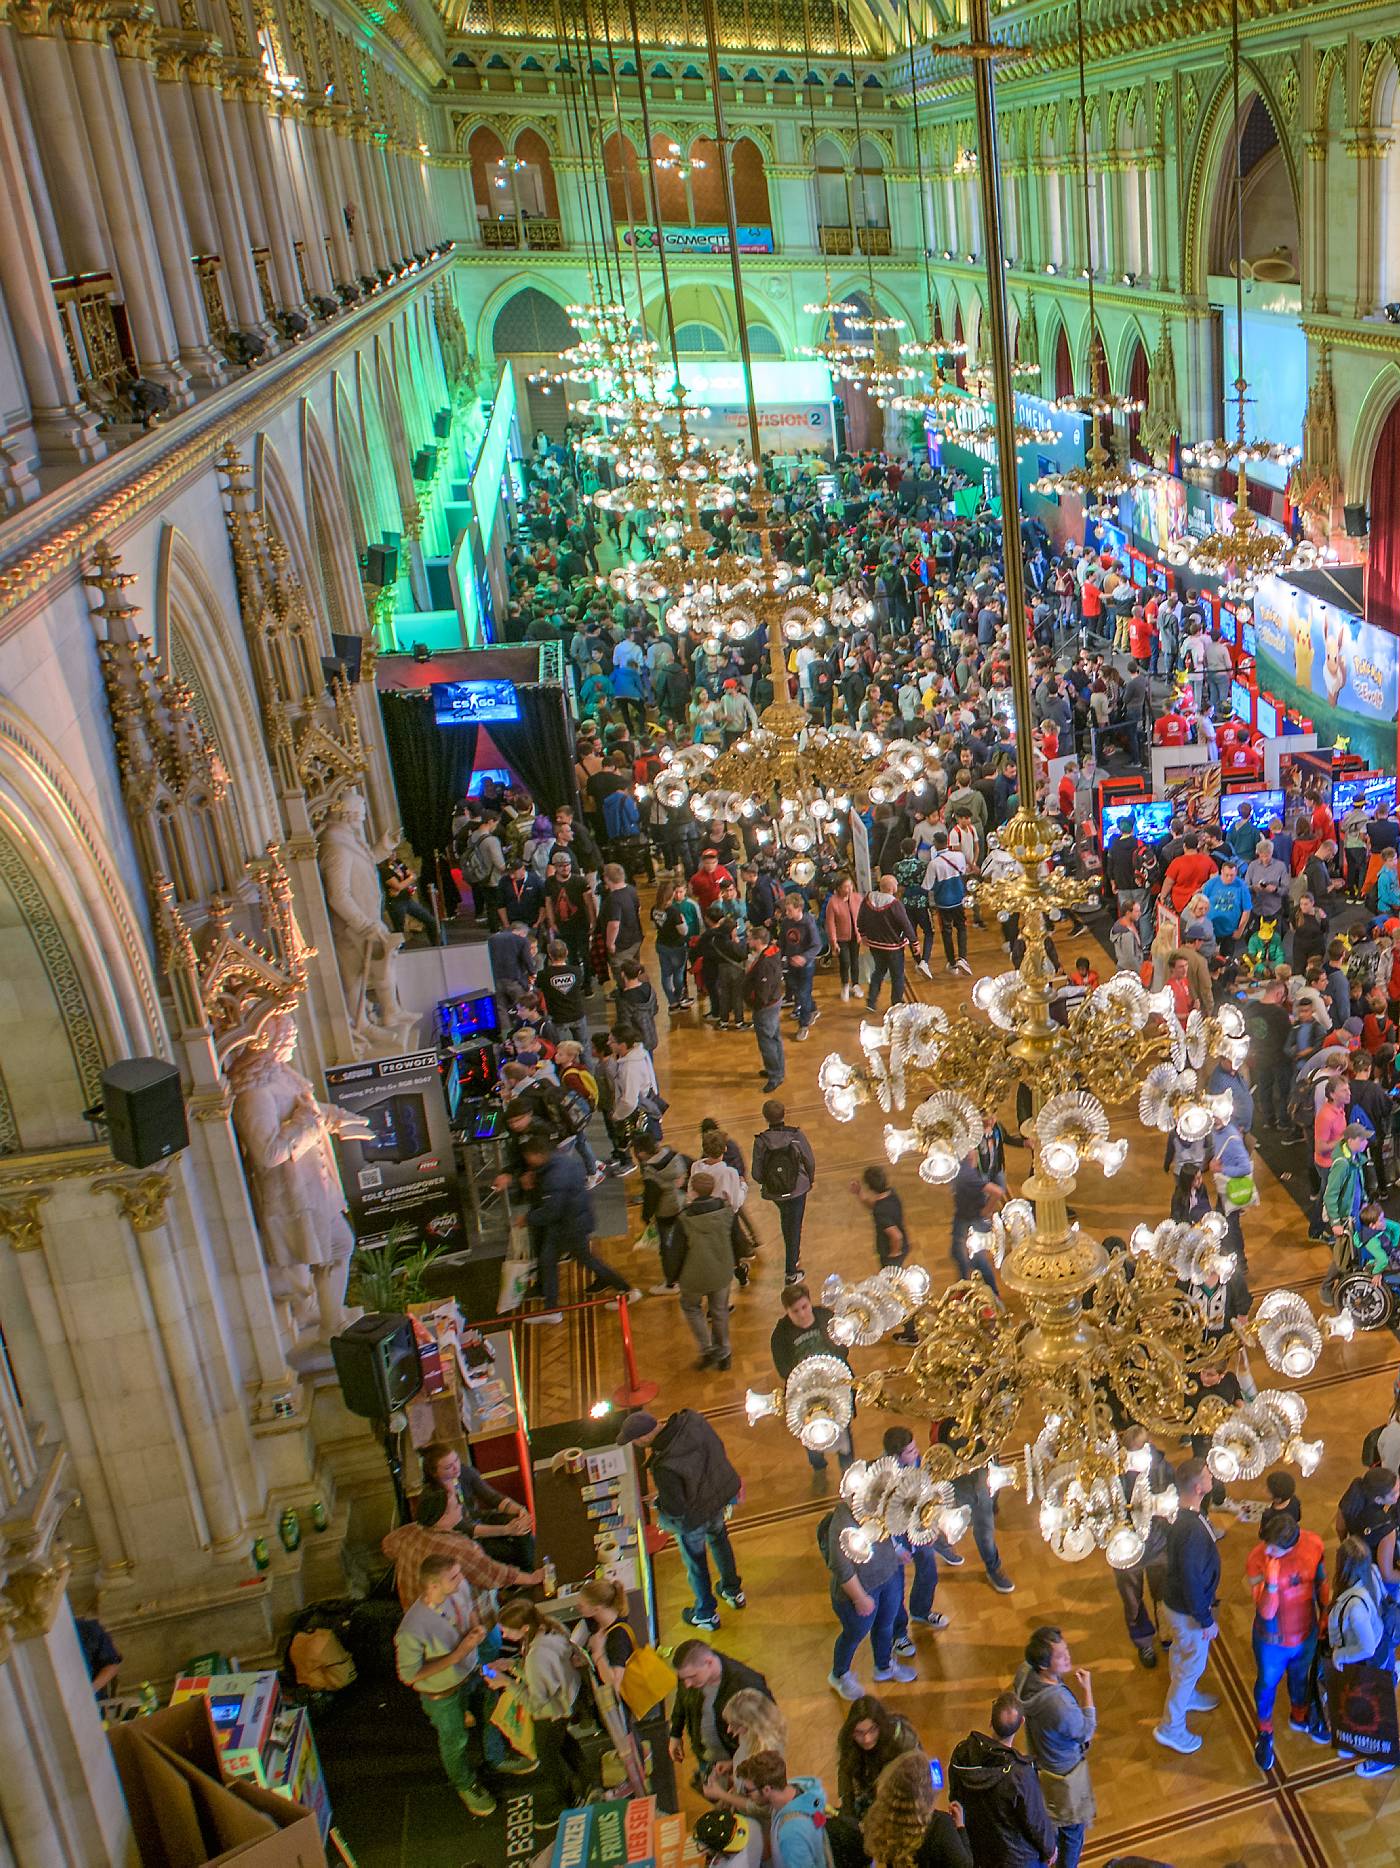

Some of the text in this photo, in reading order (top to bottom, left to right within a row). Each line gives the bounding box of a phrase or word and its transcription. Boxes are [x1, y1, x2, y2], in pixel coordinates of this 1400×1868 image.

[737, 413, 808, 428] DVISION
[811, 413, 821, 425] 2
[1019, 404, 1046, 431] OMEN
